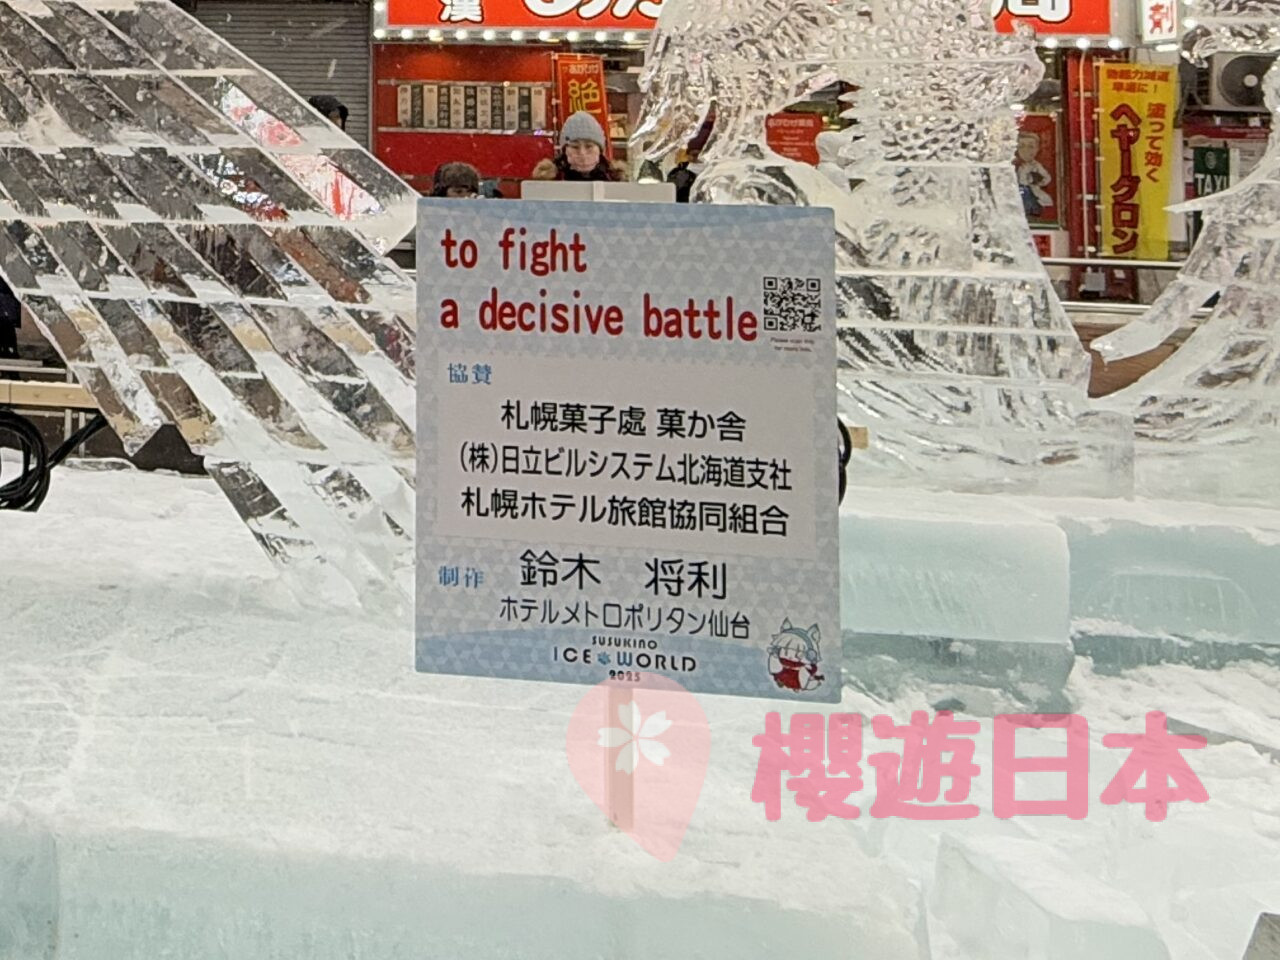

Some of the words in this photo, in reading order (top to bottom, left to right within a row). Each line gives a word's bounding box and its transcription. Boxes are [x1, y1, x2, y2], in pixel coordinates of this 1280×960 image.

[441, 229, 478, 268] to
[499, 227, 587, 276] fight
[440, 298, 459, 329] a
[479, 287, 624, 335] decisive
[643, 293, 758, 341] battle
[447, 363, 492, 385] 協賛
[500, 400, 646, 437] 札幌菓子處
[656, 407, 747, 442] 菓か舎
[459, 441, 793, 491] (株)日立ビルシステム北海道支社
[460, 486, 790, 537] 札幌ホテル旅館協同組合
[438, 565, 485, 590] 制作
[519, 548, 602, 591] 鈴木
[644, 556, 729, 600] 将利
[499, 595, 751, 640] ホテルメトロポリタン仙台
[553, 646, 592, 665] ICE
[616, 651, 697, 672] WORLD
[608, 669, 641, 682] 2025
